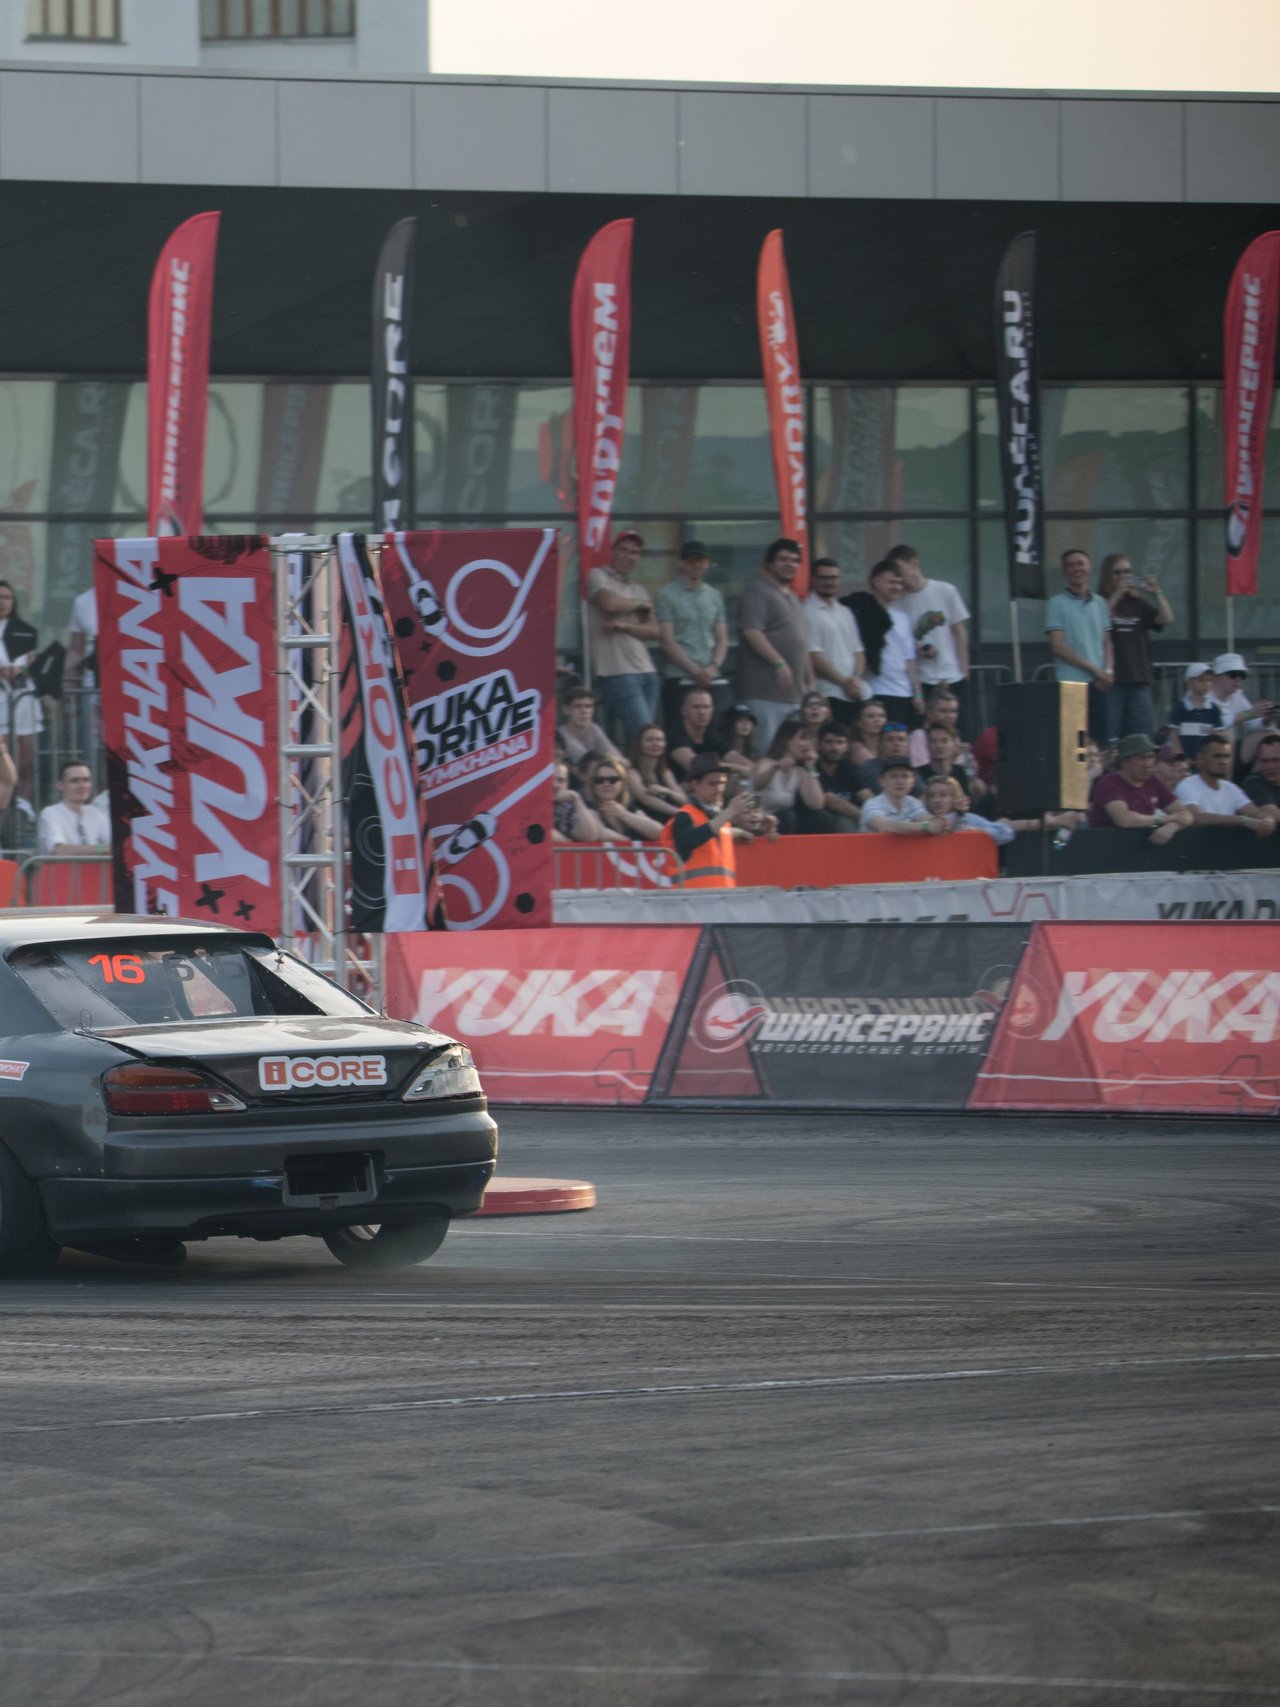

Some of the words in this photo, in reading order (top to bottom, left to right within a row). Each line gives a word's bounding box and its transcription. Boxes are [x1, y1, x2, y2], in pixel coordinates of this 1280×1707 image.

[114, 538, 179, 917] GYMKHANA
[177, 576, 271, 887] YUKA
[421, 735, 528, 789] YMKHANA
[88, 954, 146, 984] 16
[412, 968, 663, 1037] YUKA
[757, 1011, 995, 1043] ШИНСЕРВИС
[1040, 971, 1280, 1043] YUKA
[750, 1041, 906, 1055] АВТОСЕРВИСНЫЕ
